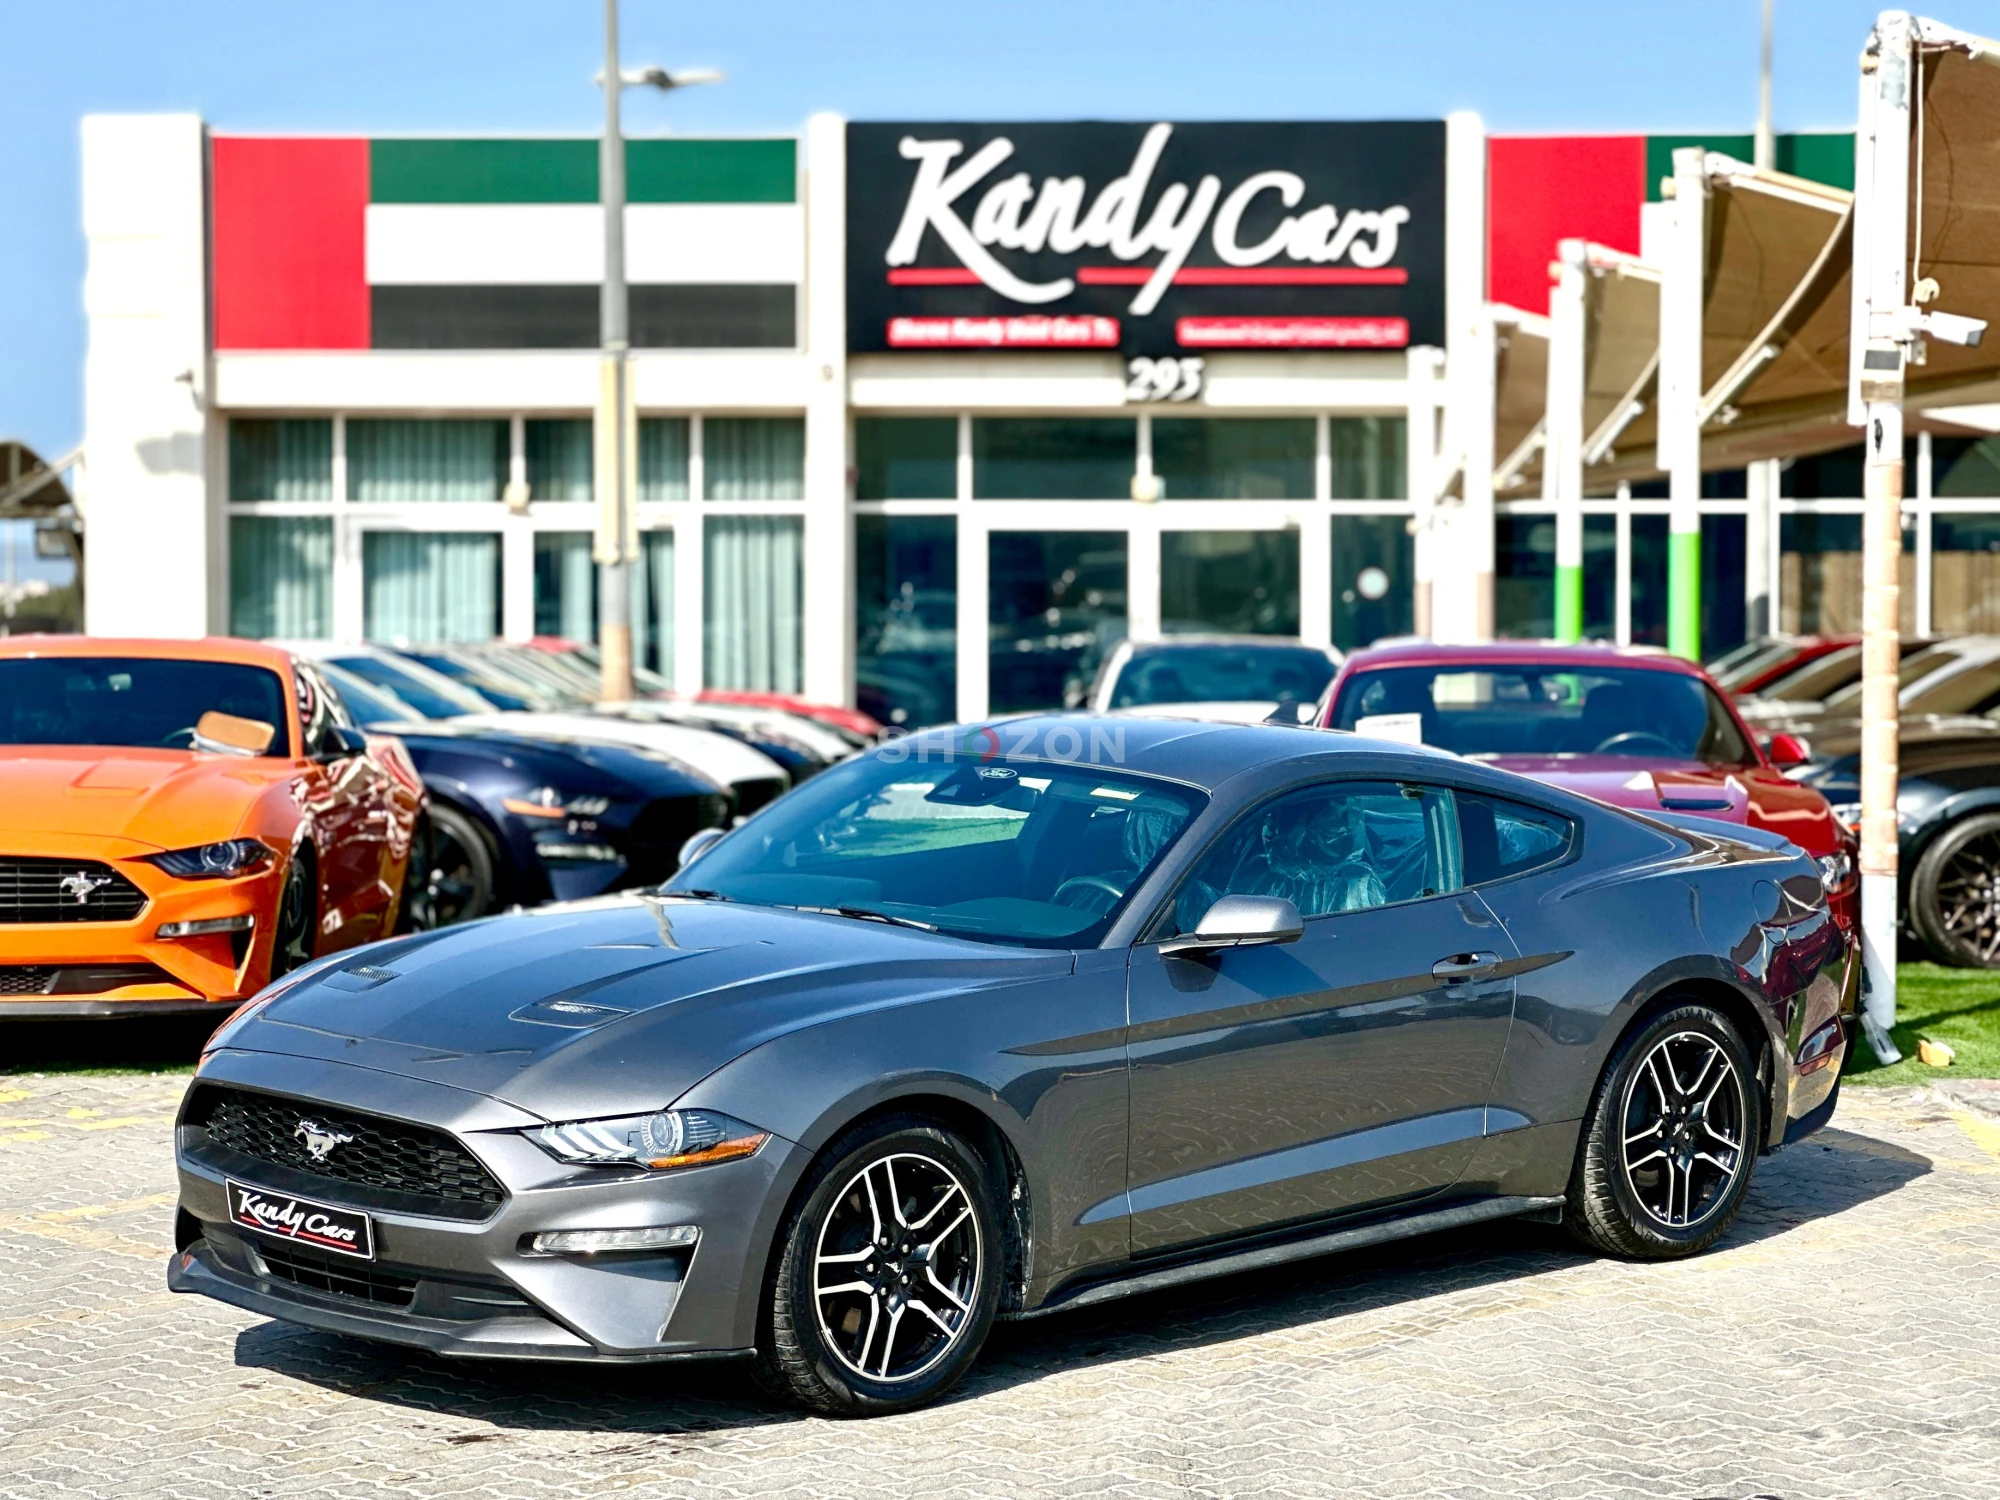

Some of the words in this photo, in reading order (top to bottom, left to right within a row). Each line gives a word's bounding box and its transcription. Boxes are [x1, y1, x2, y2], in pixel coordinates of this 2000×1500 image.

[886, 122, 1220, 315] Kandy
[1212, 171, 1410, 268] Cars
[1127, 356, 1205, 401] 295
[237, 1189, 305, 1237] Kandy
[305, 1213, 356, 1242] Cars
